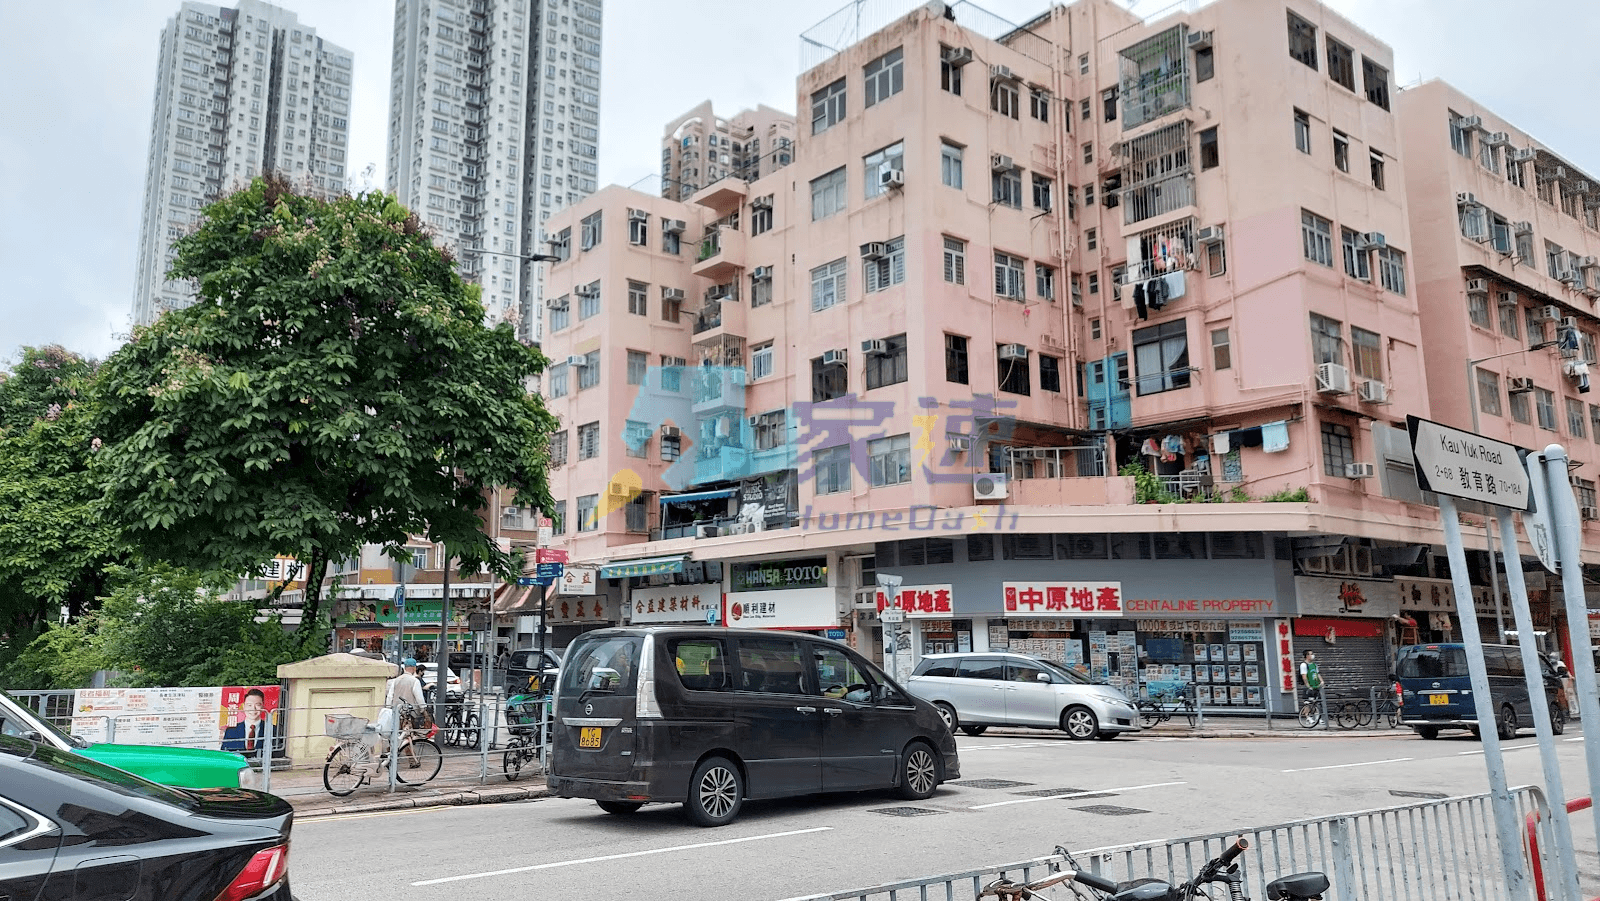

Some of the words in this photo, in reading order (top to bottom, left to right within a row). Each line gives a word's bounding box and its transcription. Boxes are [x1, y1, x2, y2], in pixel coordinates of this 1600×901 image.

[1439, 434, 1460, 454] Kau
[1460, 440, 1479, 460] Yuk
[1480, 445, 1503, 465] Road
[1458, 466, 1498, 496] 教育路
[746, 568, 780, 584] HANSA
[784, 565, 821, 581] TOTO
[743, 602, 776, 614] 順利建材
[1019, 587, 1121, 611] 中原地產
[1126, 599, 1200, 611] CENTALINE
[1203, 599, 1274, 611] PROPERTY
